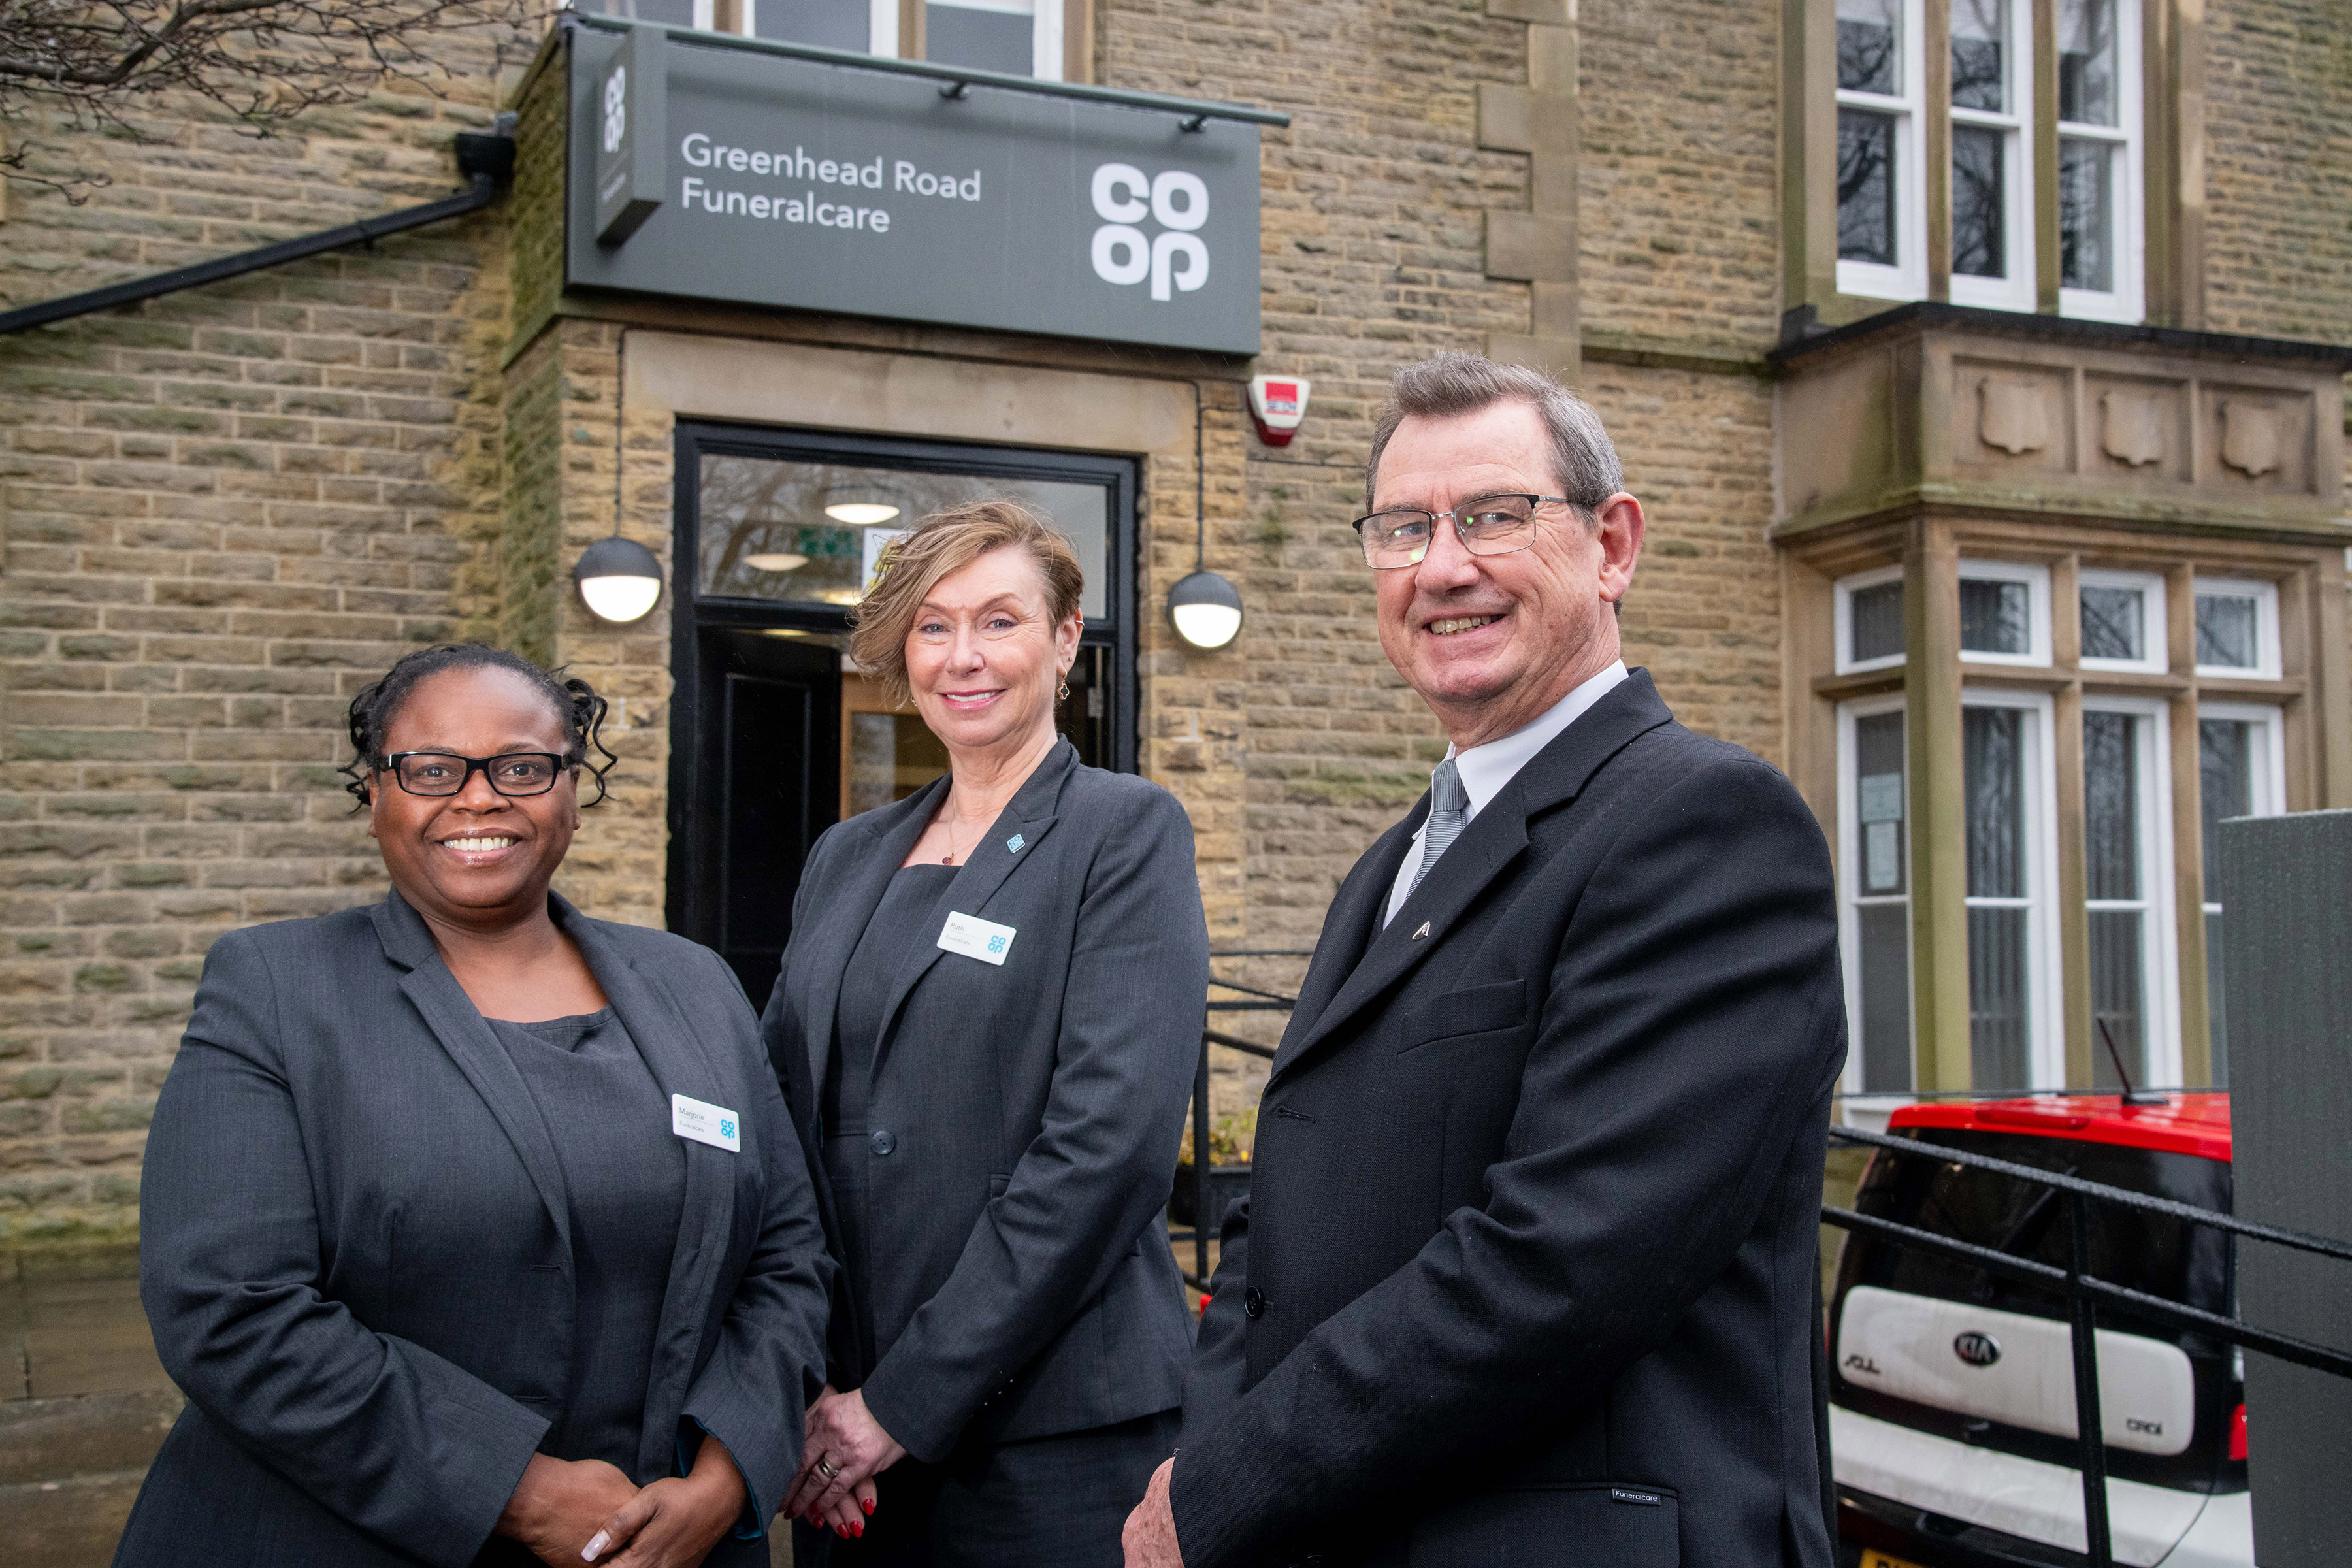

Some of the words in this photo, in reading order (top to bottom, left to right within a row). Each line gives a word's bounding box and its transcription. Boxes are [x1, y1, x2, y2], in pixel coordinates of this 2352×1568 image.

[681, 133, 883, 189] Greenhead
[894, 159, 981, 201] Road
[681, 176, 890, 233] Funeralcare
[950, 922, 964, 932] Ruth
[945, 934, 971, 946] Funeralcare
[679, 1107, 705, 1121] Marjorie
[679, 1120, 705, 1133] Funeralcare
[1615, 1490, 1658, 1501] Funeralcare
